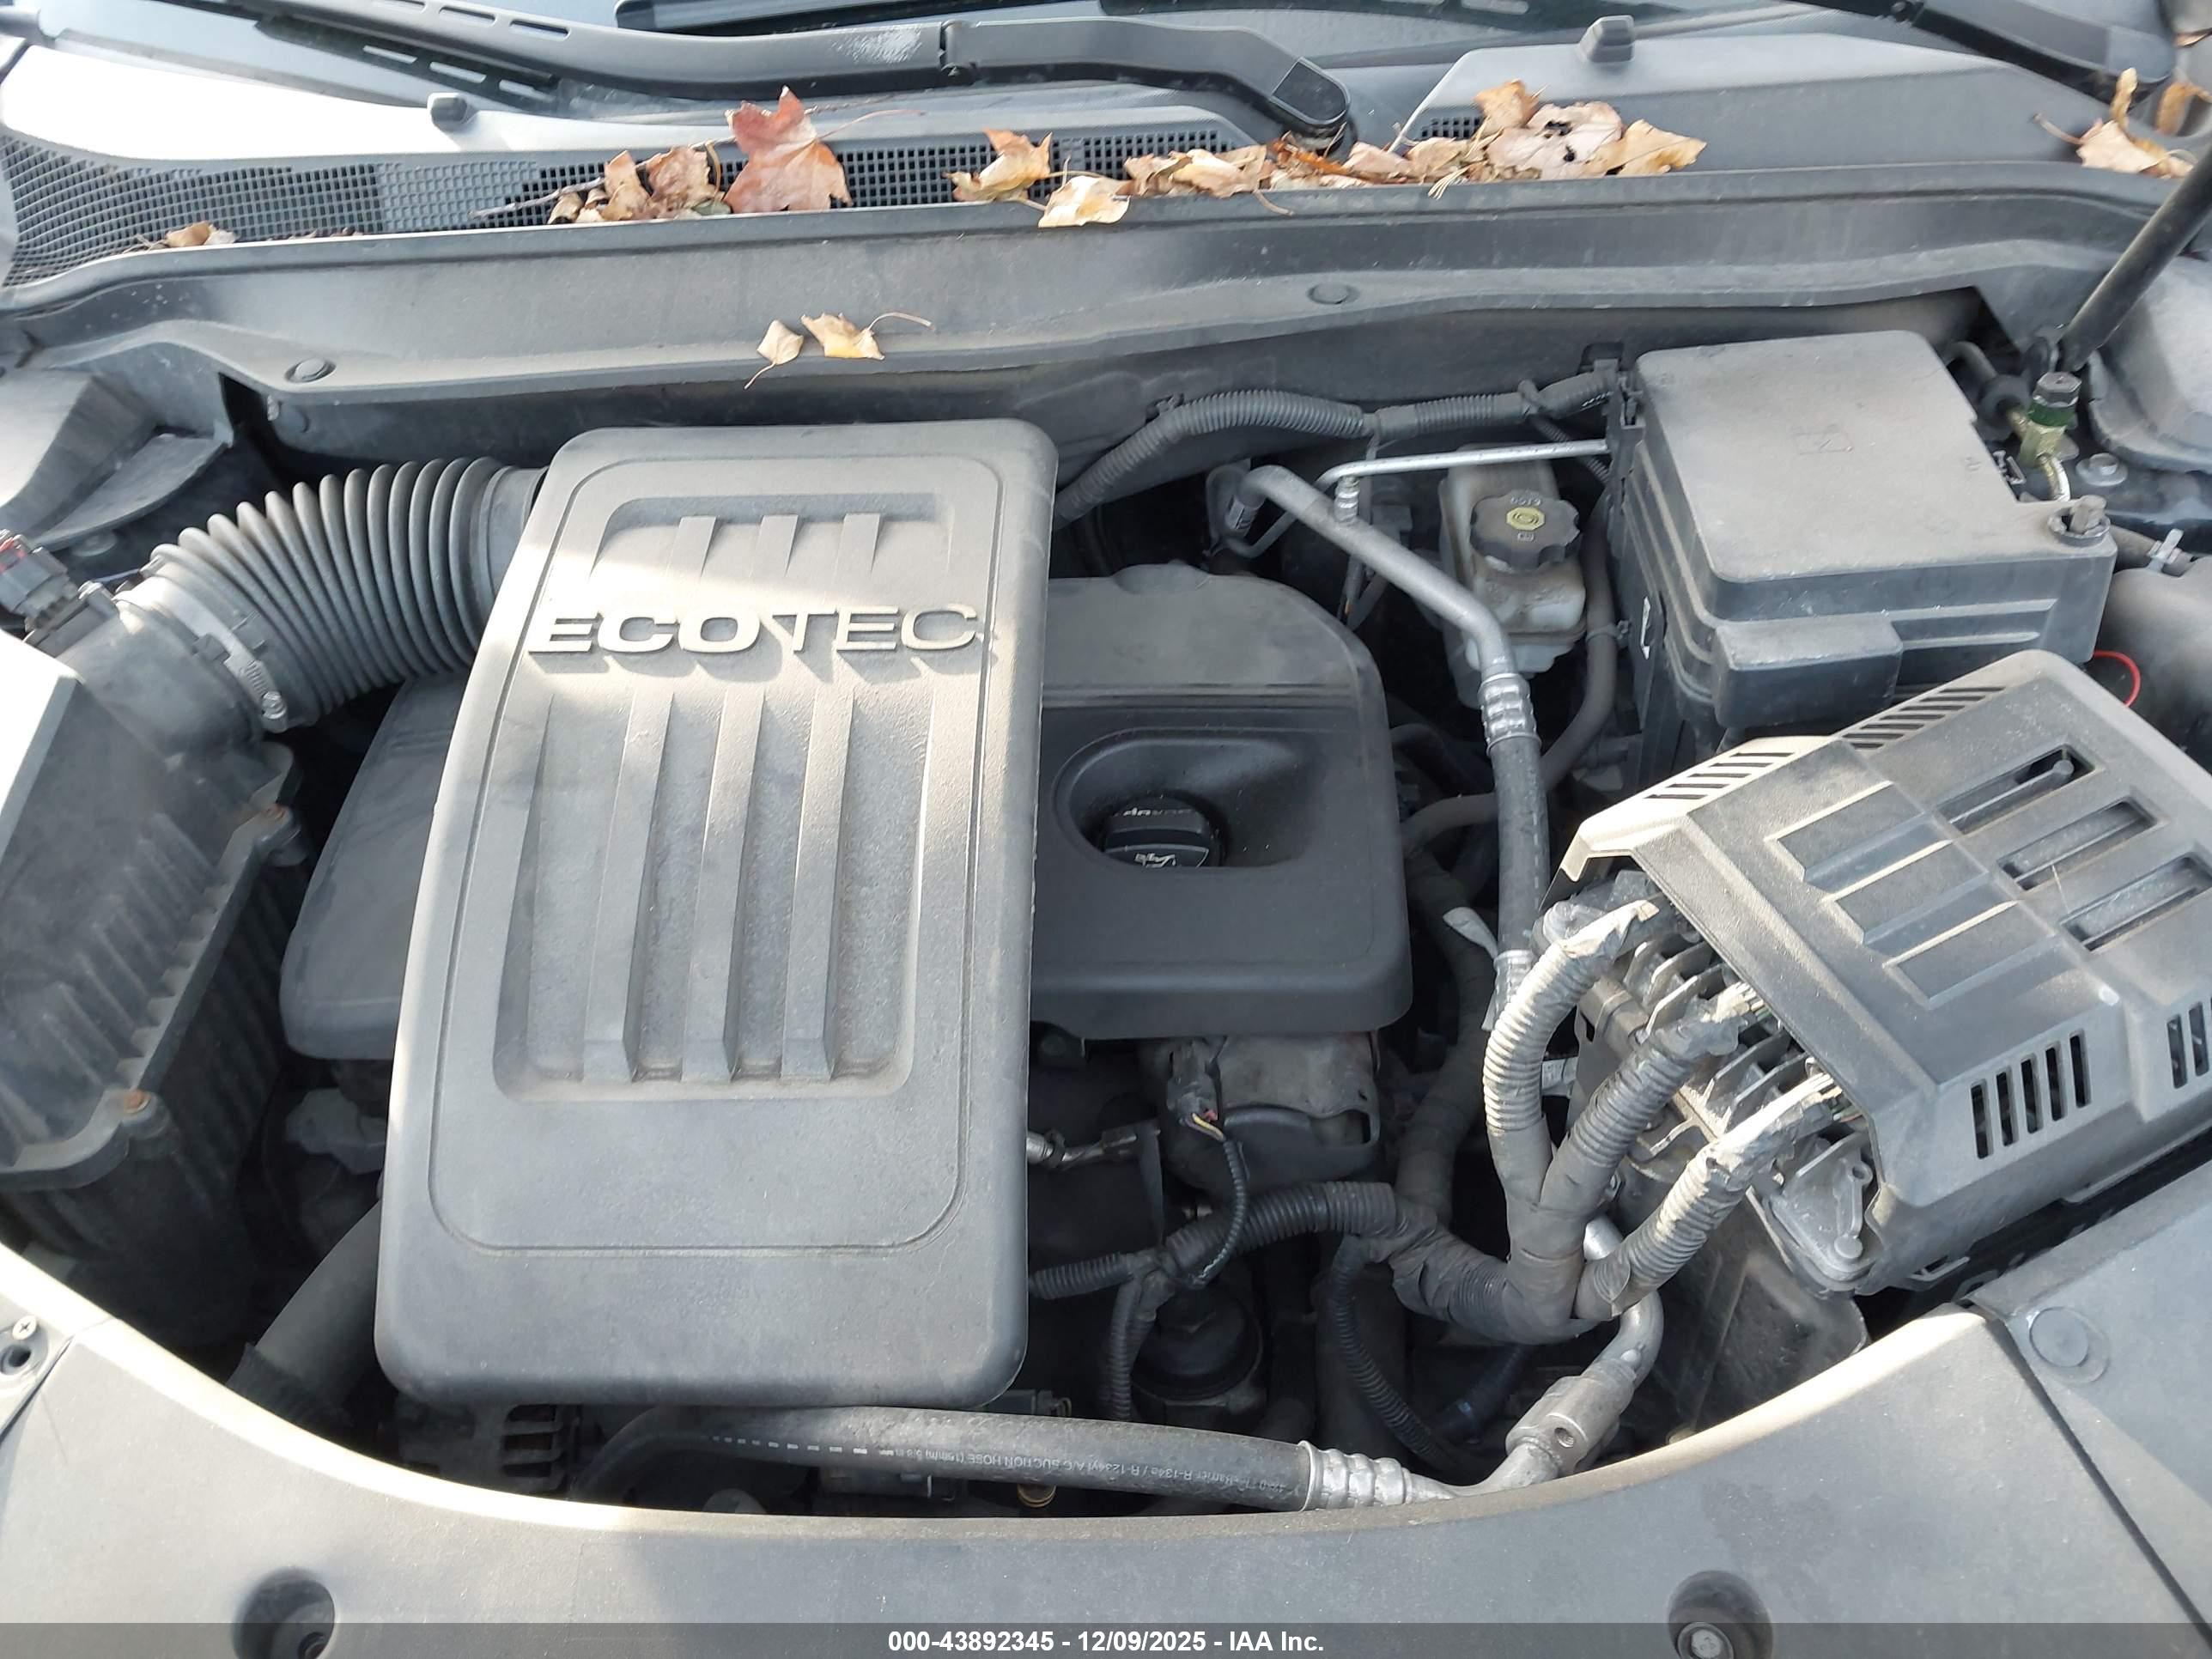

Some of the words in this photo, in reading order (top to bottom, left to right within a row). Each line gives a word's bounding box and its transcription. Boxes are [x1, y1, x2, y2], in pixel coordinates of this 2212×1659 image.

[527, 603, 977, 653] ECOTEC
[968, 1453, 1001, 1465] HOSE
[1004, 1455, 1060, 1469] SUCTION
[1064, 1461, 1085, 1471] A/C
[1152, 1467, 1192, 1480] R-134a
